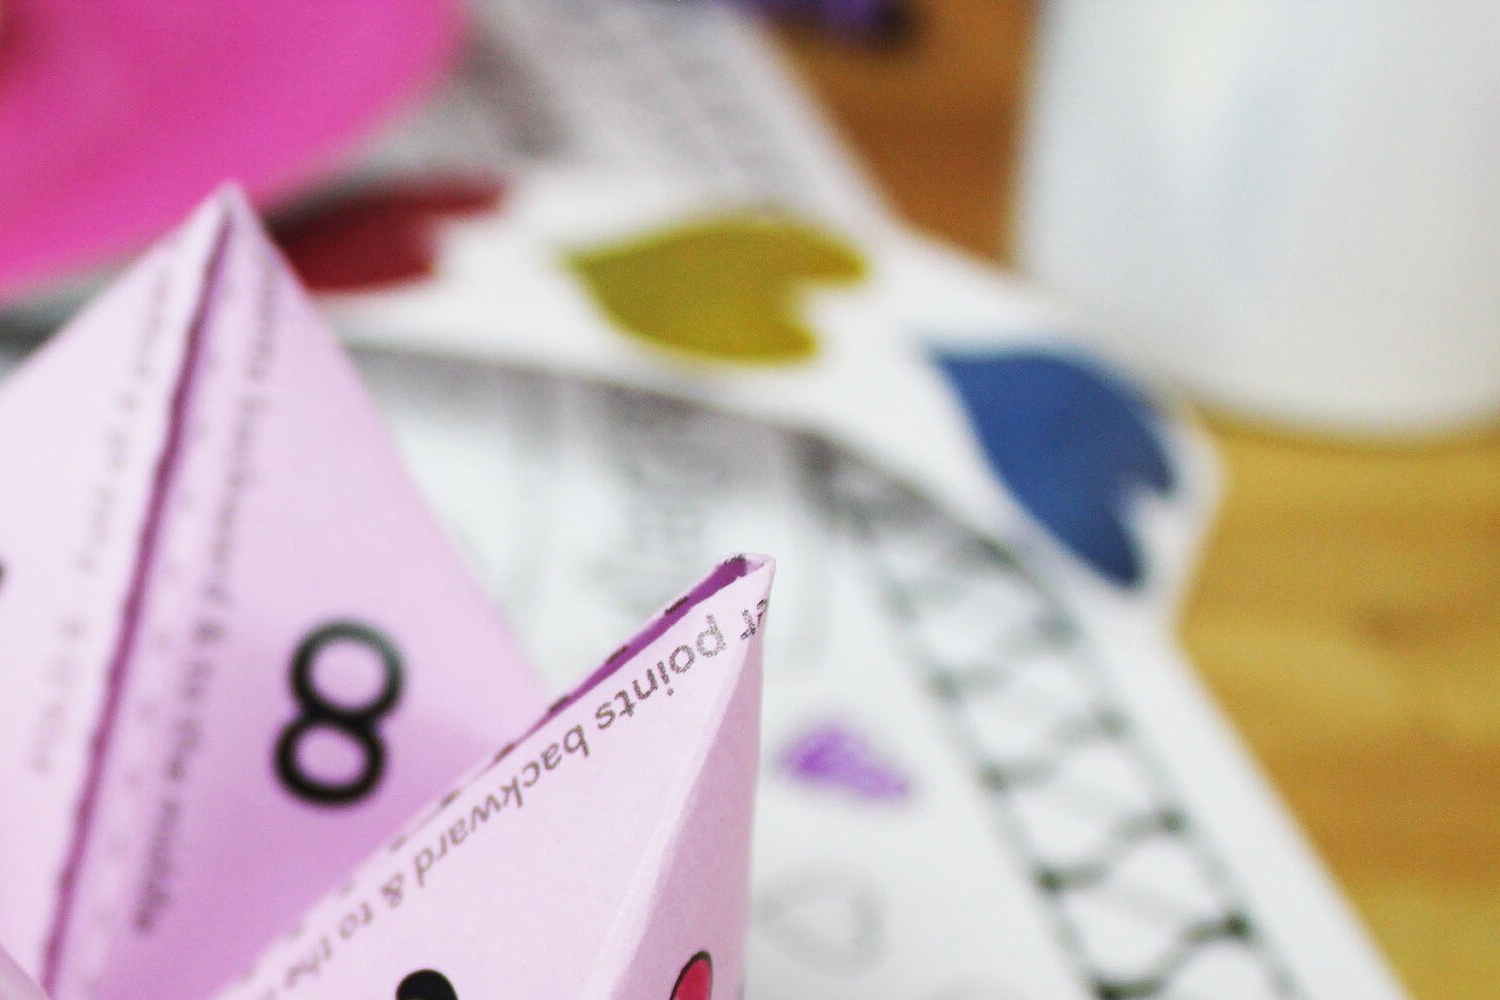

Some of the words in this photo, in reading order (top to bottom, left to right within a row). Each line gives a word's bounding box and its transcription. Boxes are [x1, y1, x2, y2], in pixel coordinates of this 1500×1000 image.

[272, 616, 407, 810] 8
[595, 613, 727, 733] points
[413, 722, 593, 890] backward
[338, 901, 375, 941] to
[379, 880, 406, 908] &
